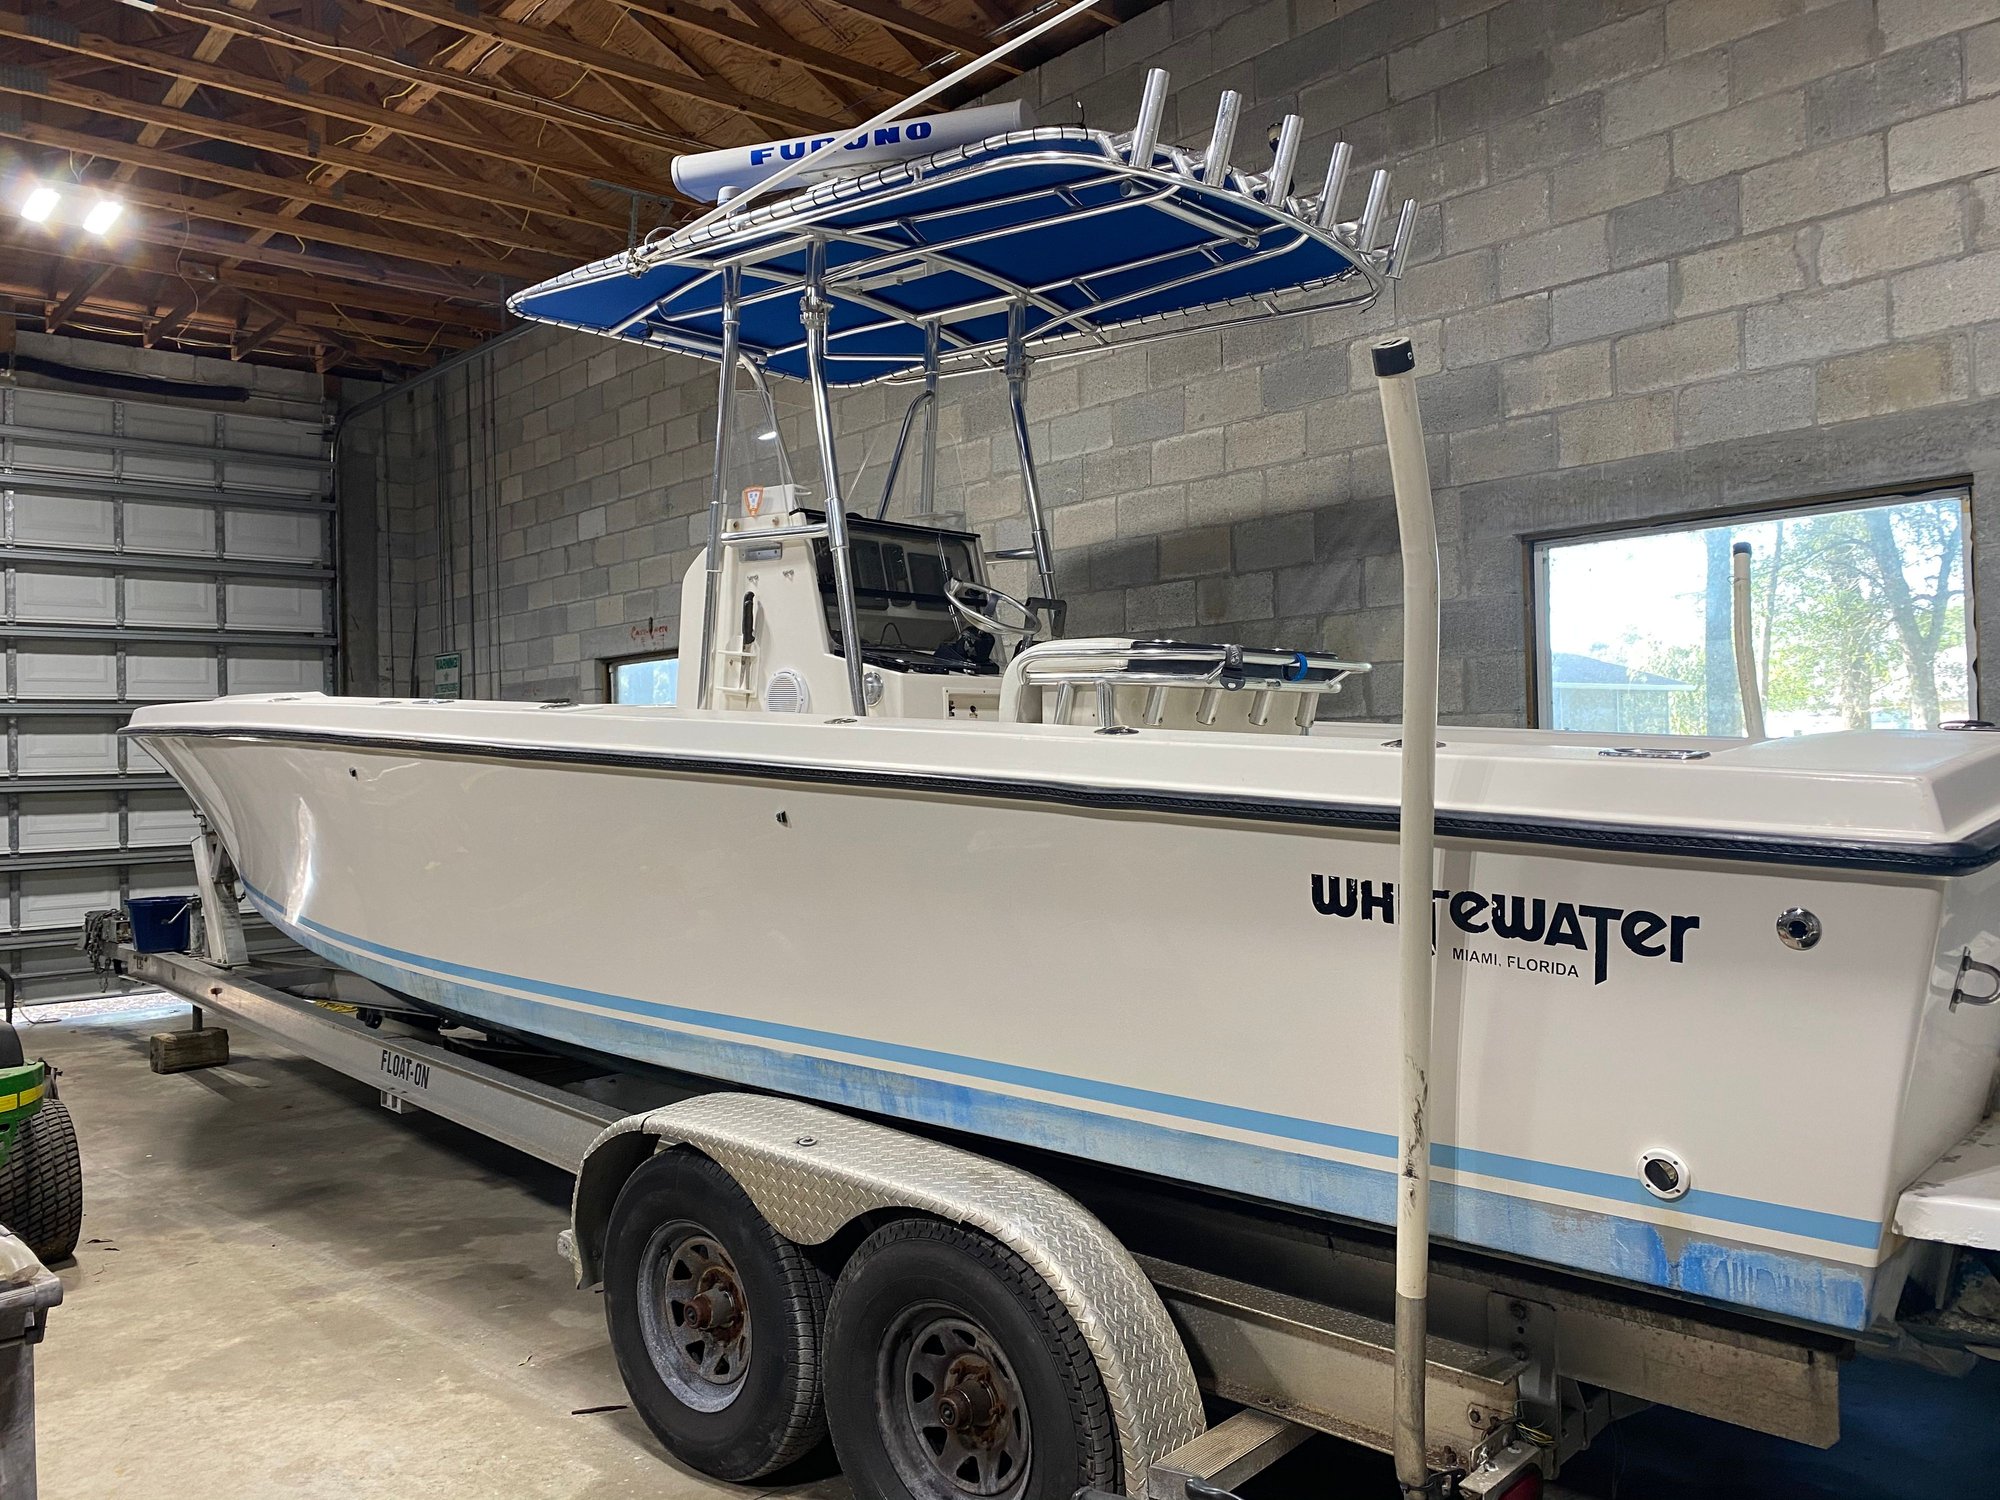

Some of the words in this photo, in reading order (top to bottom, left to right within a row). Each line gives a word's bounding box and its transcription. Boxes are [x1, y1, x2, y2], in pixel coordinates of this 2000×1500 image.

[1452, 947, 1502, 967] MIAMI,
[1507, 955, 1579, 978] FLORIDA
[380, 1049, 430, 1089] FLOAT-ON
